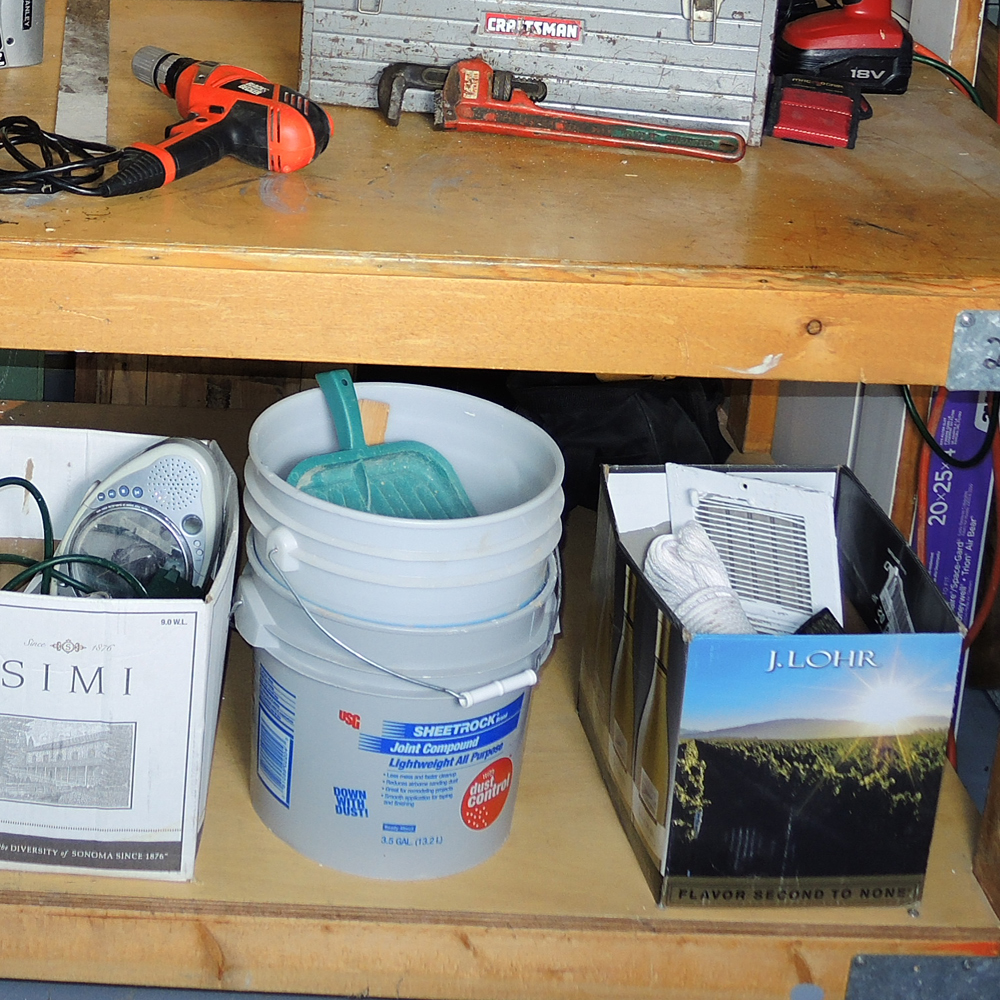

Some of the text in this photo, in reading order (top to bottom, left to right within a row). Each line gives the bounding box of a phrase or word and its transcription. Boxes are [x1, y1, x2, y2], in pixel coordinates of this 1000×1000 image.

[851, 69, 885, 80] 18V
[161, 618, 172, 626] 9.0
[23, 639, 46, 648] Since
[91, 643, 116, 652] 1876
[1, 660, 133, 696] SIMI
[339, 709, 361, 731] USG
[390, 736, 480, 755] Joint Compound
[389, 743, 504, 771] Lightweight All Purpose
[467, 772, 511, 808] control
[469, 775, 495, 796] dust
[333, 786, 368, 800] DOWN
[336, 796, 366, 810] WITH
[335, 804, 369, 818] DUST!
[381, 836, 394, 845] 3.5
[10, 844, 58, 857] DIVERSITY
[60, 848, 69, 859] of
[71, 850, 113, 860] SONOMA
[116, 852, 143, 861] SINCE
[678, 888, 745, 901] FLAVOR
[753, 889, 825, 901] SECOND
[832, 888, 852, 900] TO
